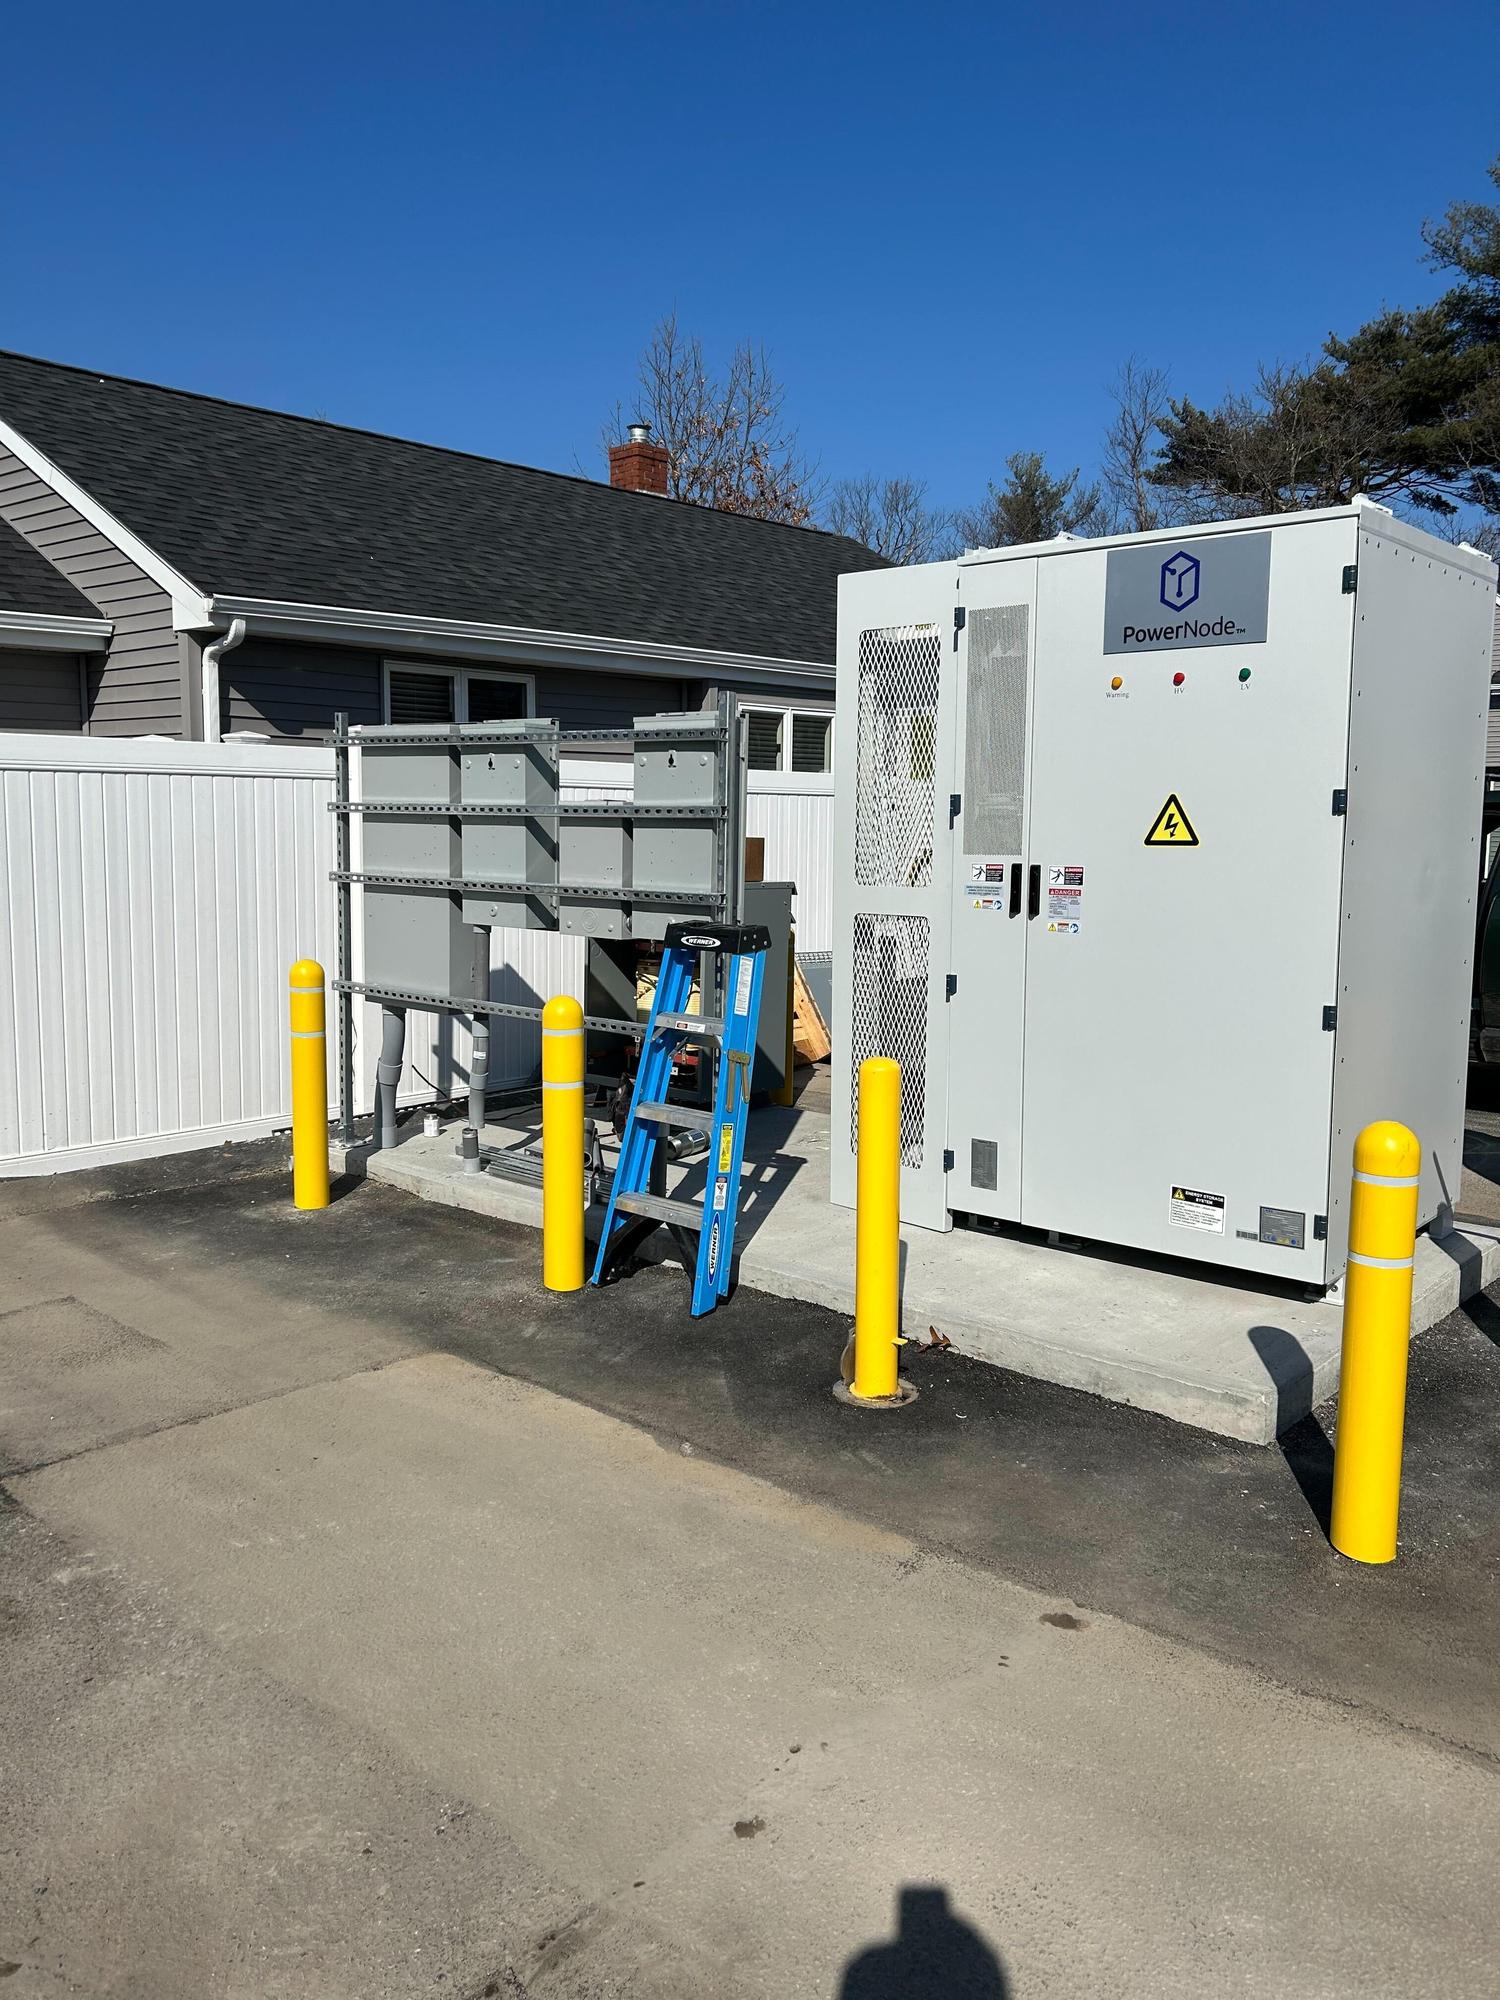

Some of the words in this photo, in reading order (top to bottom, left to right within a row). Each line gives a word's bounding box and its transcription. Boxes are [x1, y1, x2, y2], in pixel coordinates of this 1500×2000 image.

[1105, 691, 1130, 699] Warning
[1185, 1190, 1203, 1198] ENERGY
[1203, 1194, 1224, 1203] STORAGE
[1196, 1197, 1214, 1205] SYSTEM
